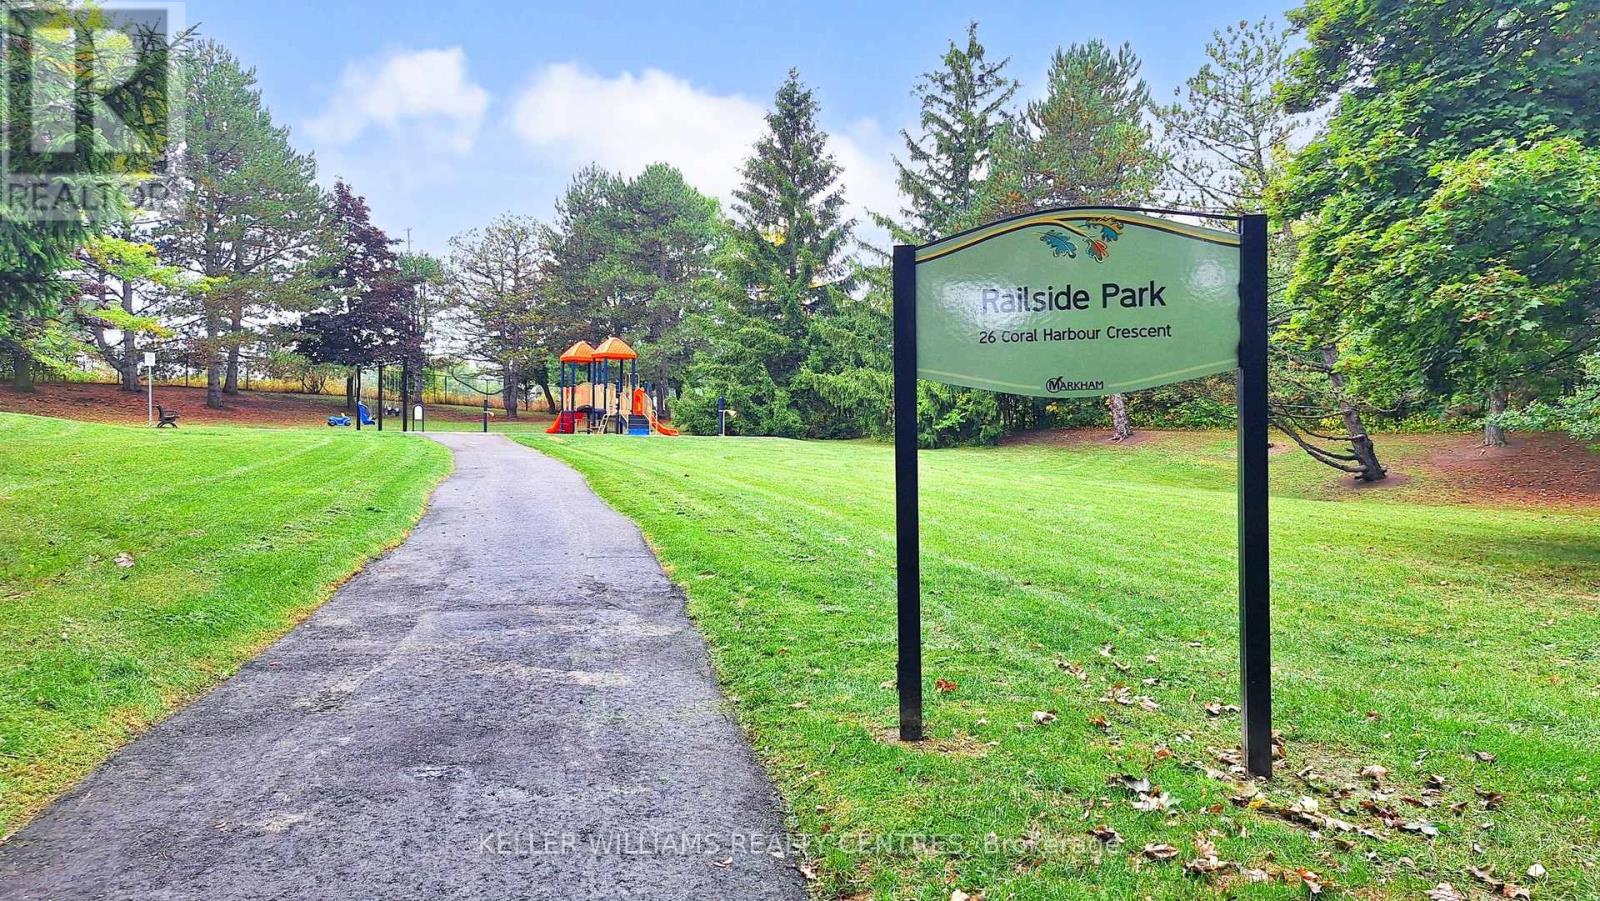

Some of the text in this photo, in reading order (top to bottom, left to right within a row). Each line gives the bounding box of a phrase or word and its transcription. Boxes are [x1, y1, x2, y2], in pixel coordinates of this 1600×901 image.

[982, 280, 1167, 314] Railside Park
[979, 324, 1172, 344] 26 Coral Harbour Crescent
